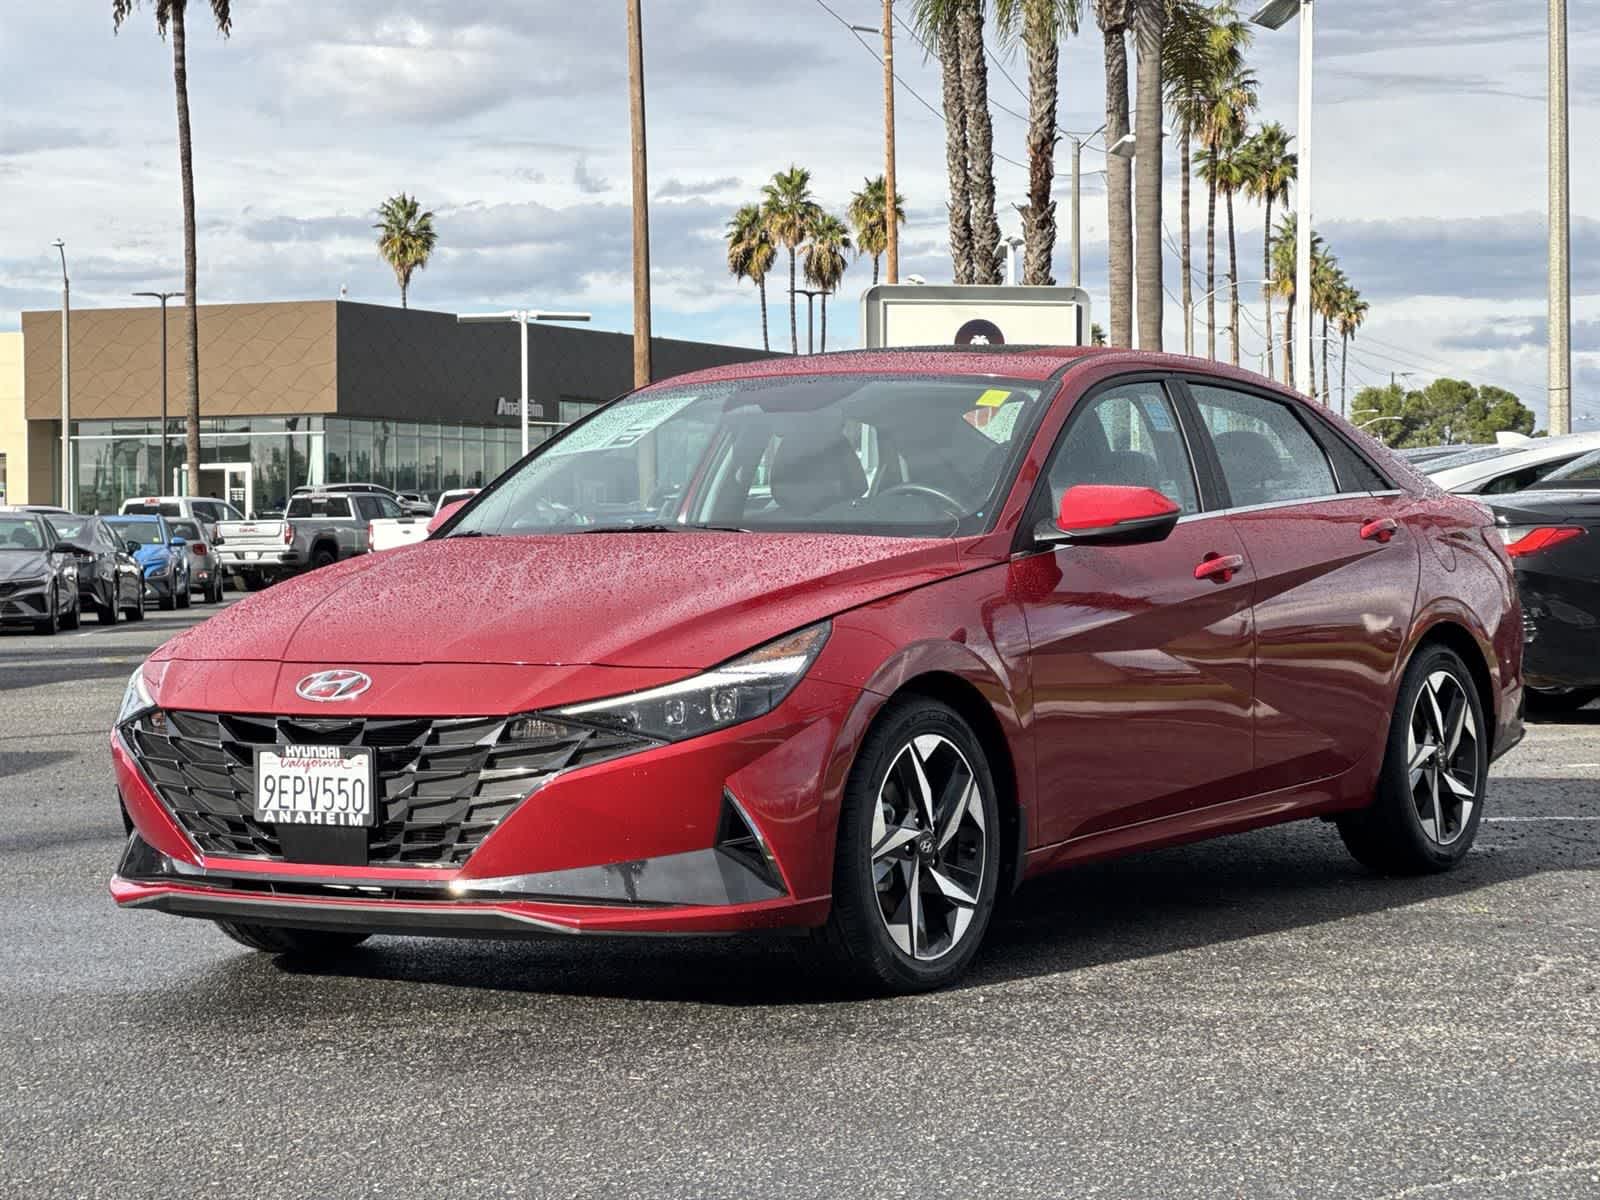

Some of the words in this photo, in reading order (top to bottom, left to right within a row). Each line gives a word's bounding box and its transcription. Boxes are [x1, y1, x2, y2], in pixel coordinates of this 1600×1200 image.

[285, 745, 341, 758] HYUNDAI
[263, 775, 365, 812] 9EPV550
[263, 811, 364, 826] ANAHEIM
